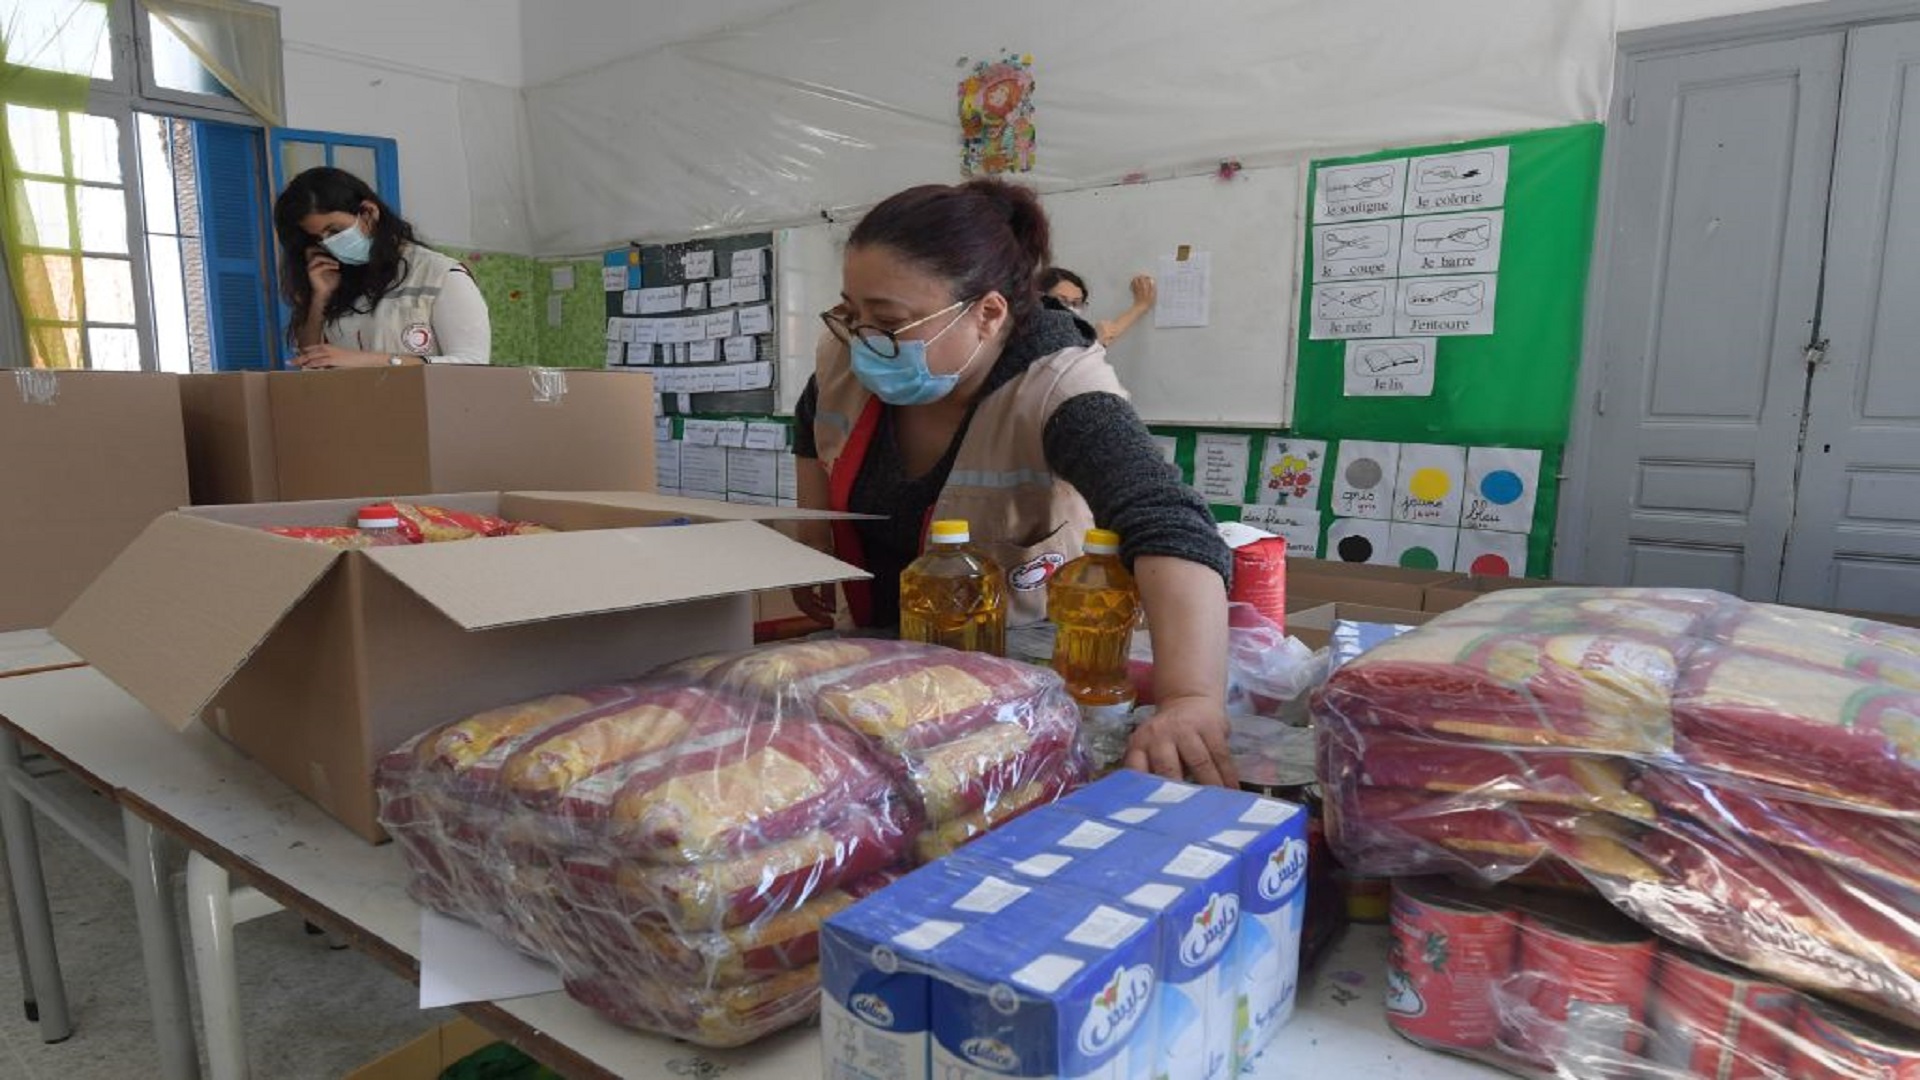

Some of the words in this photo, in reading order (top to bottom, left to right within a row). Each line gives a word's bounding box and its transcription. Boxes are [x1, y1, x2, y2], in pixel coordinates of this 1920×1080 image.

[1415, 195, 1429, 208] Je
[1435, 192, 1482, 206] colorie
[1421, 257, 1435, 269] Je
[1441, 256, 1476, 268] barre
[1349, 264, 1386, 276] coupe
[1329, 320, 1341, 333] Je
[1374, 379, 1387, 391] Je
